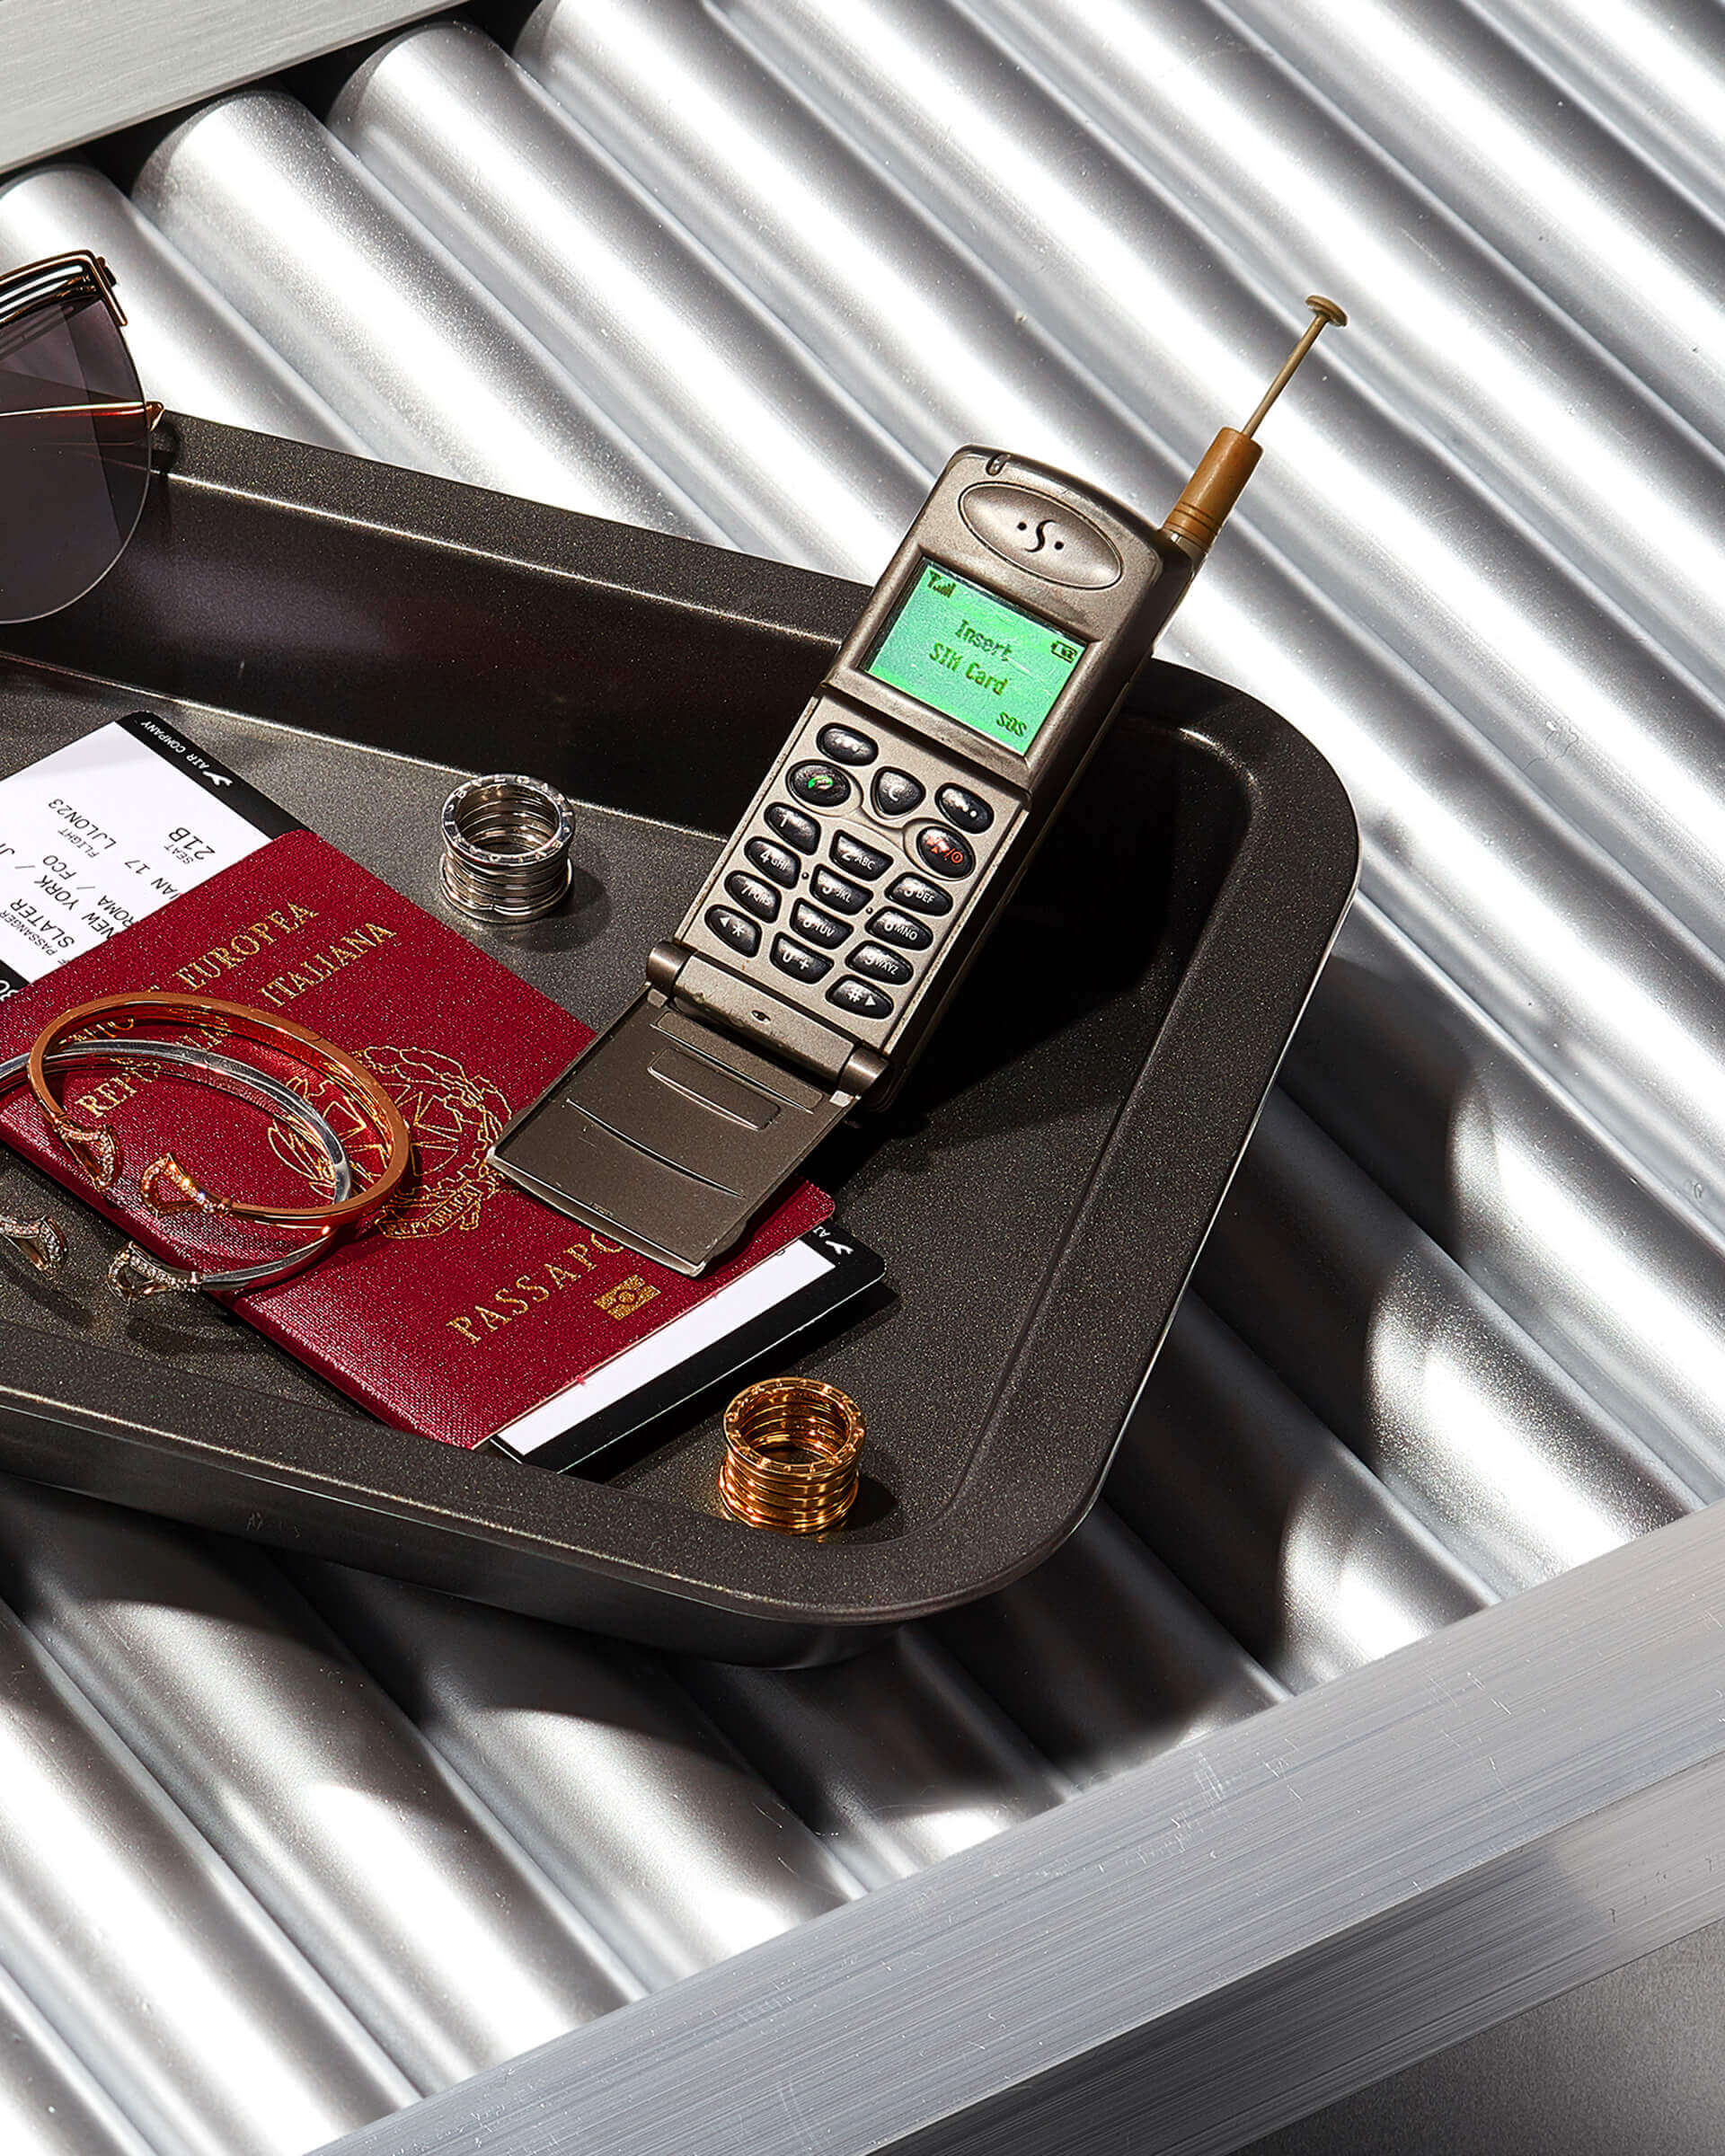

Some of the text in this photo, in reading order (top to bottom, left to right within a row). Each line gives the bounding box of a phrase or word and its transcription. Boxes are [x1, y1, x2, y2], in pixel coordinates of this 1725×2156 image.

[955, 619, 1013, 662] Insert
[928, 641, 1009, 696] SIM Card
[996, 711, 1028, 738] SOS
[140, 720, 210, 770] AIR COMPANY
[48, 798, 116, 850] LJLON23
[58, 827, 100, 858] FLIGHT
[164, 844, 194, 864] SEAT
[168, 826, 216, 861] 21B
[759, 849, 771, 863] 4
[42, 854, 77, 880] FCO
[124, 859, 151, 875] 17
[854, 853, 876, 870] ABC
[33, 874, 79, 911] YORK
[835, 888, 853, 904] JKL
[916, 888, 936, 905] DEF
[9, 898, 75, 949] SLATER
[81, 912, 115, 940] NEW
[97, 895, 135, 928] ROMA
[814, 923, 836, 938] TUV
[893, 923, 918, 941] MNO
[173, 901, 319, 991] EUROPEA
[259, 923, 397, 1007] ITALIANA
